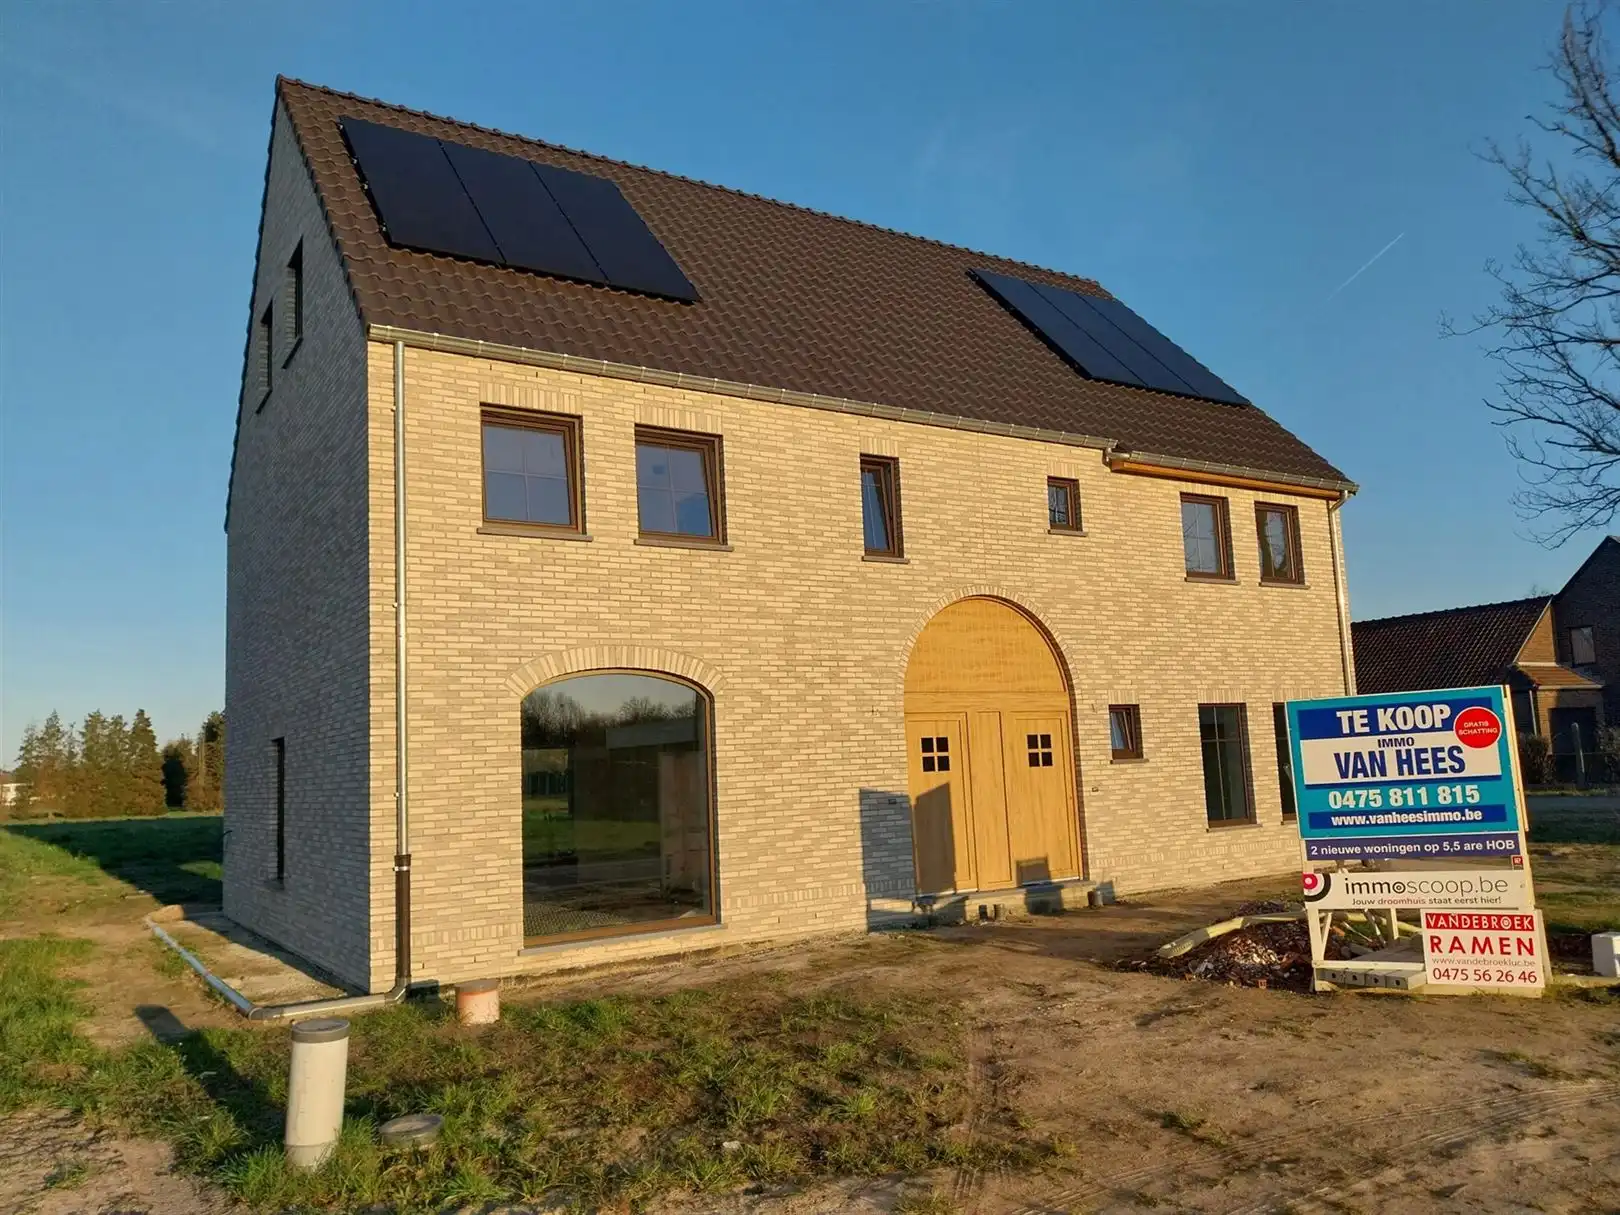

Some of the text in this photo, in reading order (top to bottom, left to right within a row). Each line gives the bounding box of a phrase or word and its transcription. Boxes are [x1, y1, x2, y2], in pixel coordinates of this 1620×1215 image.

[1336, 704, 1451, 734] TE KOOP
[1463, 720, 1489, 728] GRATIS
[1458, 727, 1498, 736] SCHATTING
[1377, 736, 1415, 749] IMMO
[1333, 745, 1466, 779] VAN HEES
[1328, 784, 1480, 809] 0475 811 815
[1331, 808, 1482, 826] www.vanheesimmo.be
[1311, 840, 1515, 855] 2 nieuwe woningen op 5,5 are HOB
[1344, 876, 1508, 896] immoscoop.be
[1352, 896, 1501, 905] Jouw droomhuis staat eerst hier!
[1427, 914, 1533, 930] VANDEBROEK
[1429, 935, 1535, 956] RAMEN
[1433, 967, 1537, 984] 0475 56 26 46
